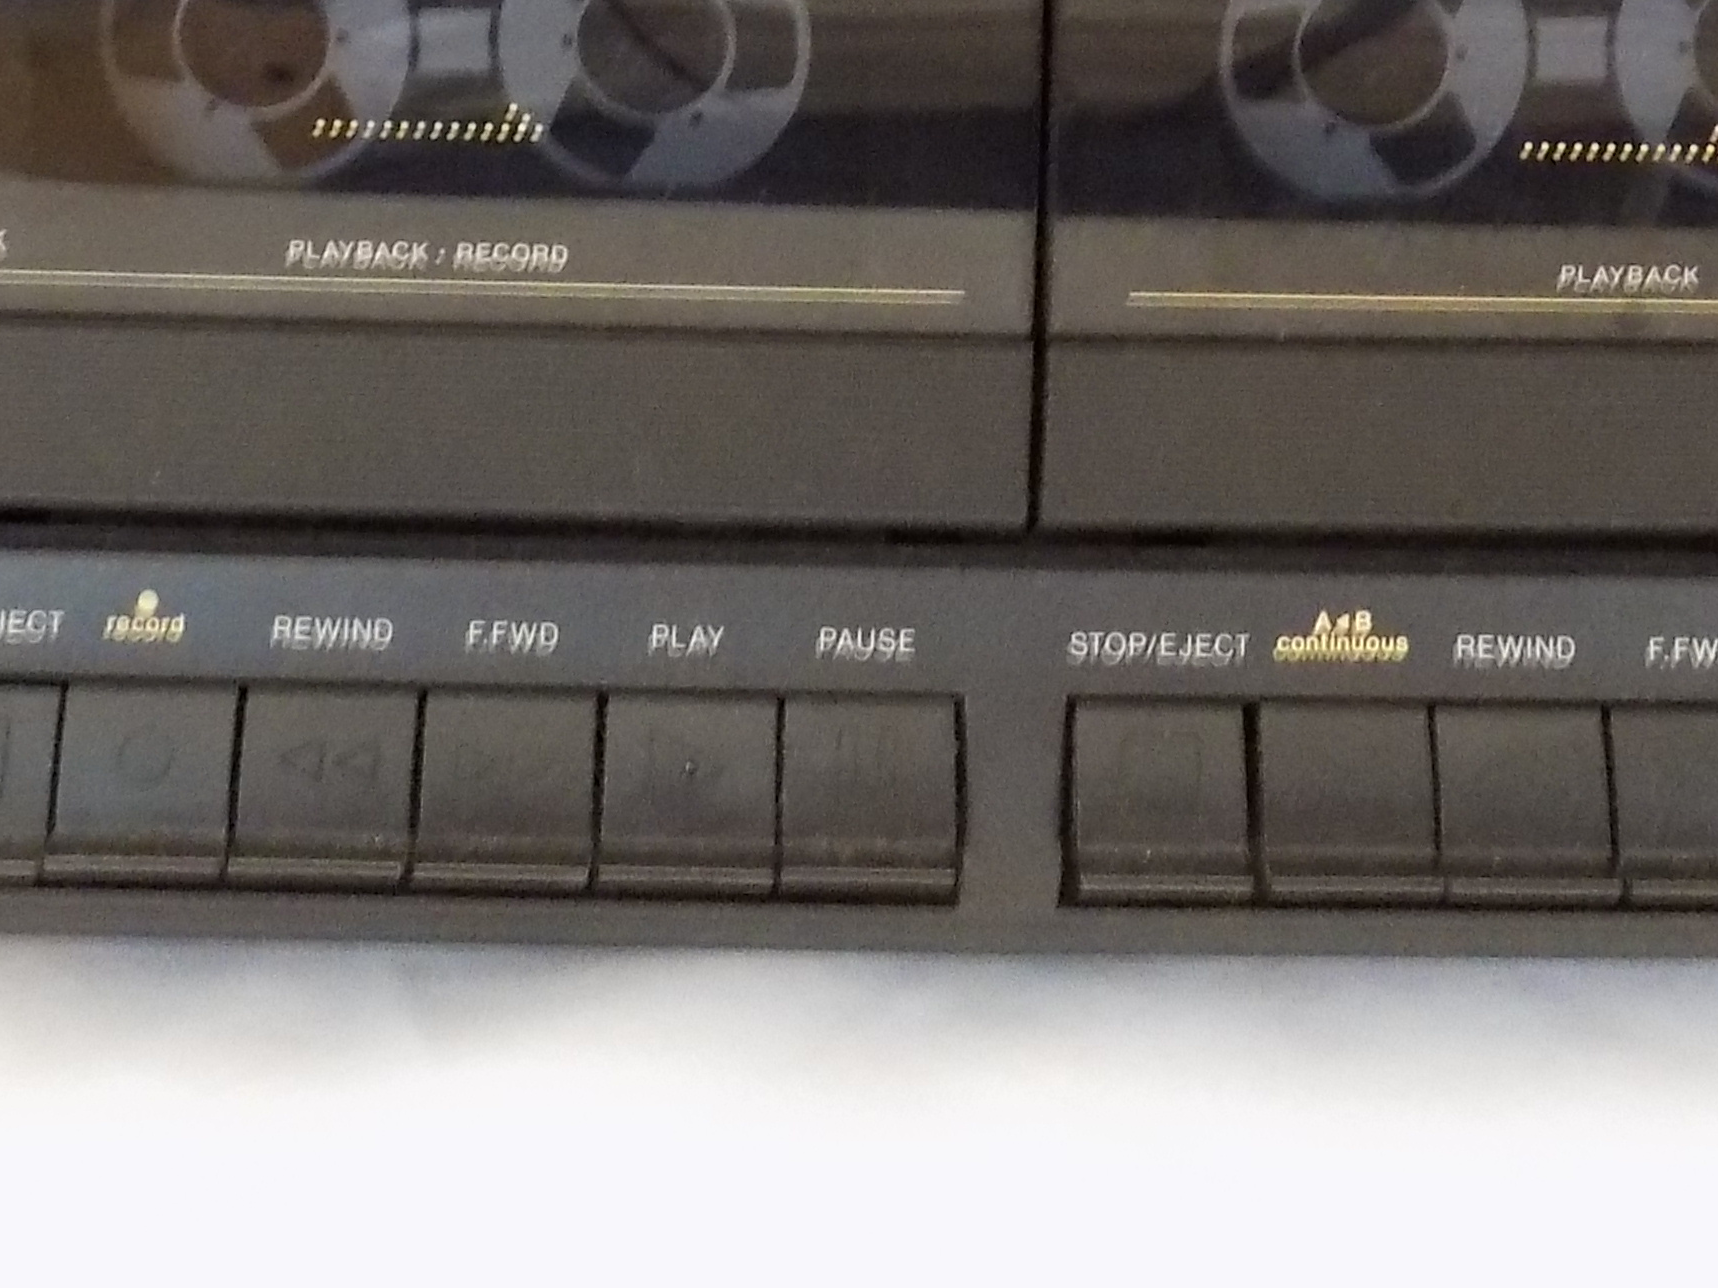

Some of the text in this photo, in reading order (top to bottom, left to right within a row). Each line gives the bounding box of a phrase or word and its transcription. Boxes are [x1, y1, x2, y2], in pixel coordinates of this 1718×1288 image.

[285, 238, 569, 275] PLAYBACK RECORD
[1557, 263, 1701, 295] PLAYBACK
[103, 612, 185, 643] record
[269, 614, 394, 652] REWIND
[466, 620, 560, 656] F.FWD
[1313, 610, 1372, 634] A B
[648, 623, 724, 657] PLAY
[816, 627, 916, 662] PAUSE
[1066, 632, 1250, 666] STOP/EJECT
[1273, 633, 1409, 662] continuous
[1453, 635, 1576, 669] REWIND
